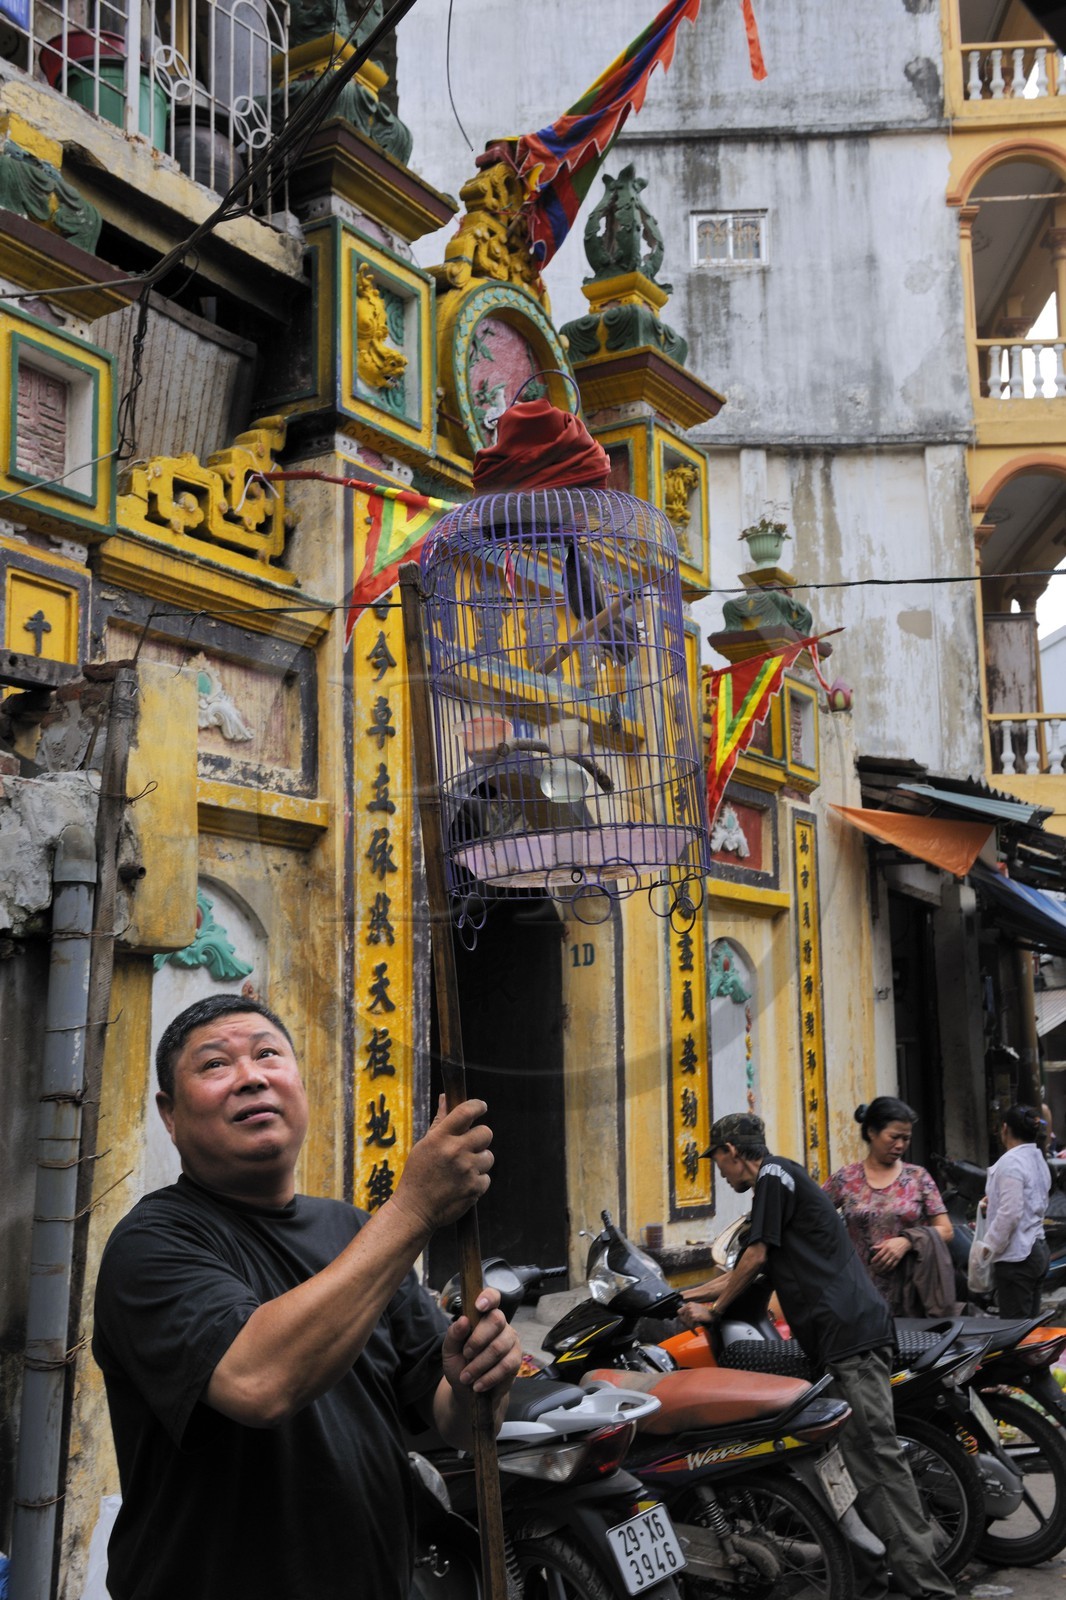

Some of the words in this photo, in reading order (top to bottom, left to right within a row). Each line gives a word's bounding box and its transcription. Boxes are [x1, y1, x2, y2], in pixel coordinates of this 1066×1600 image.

[570, 943, 595, 967] 1D
[684, 1440, 760, 1471] Wave
[630, 1542, 677, 1586] 3946
